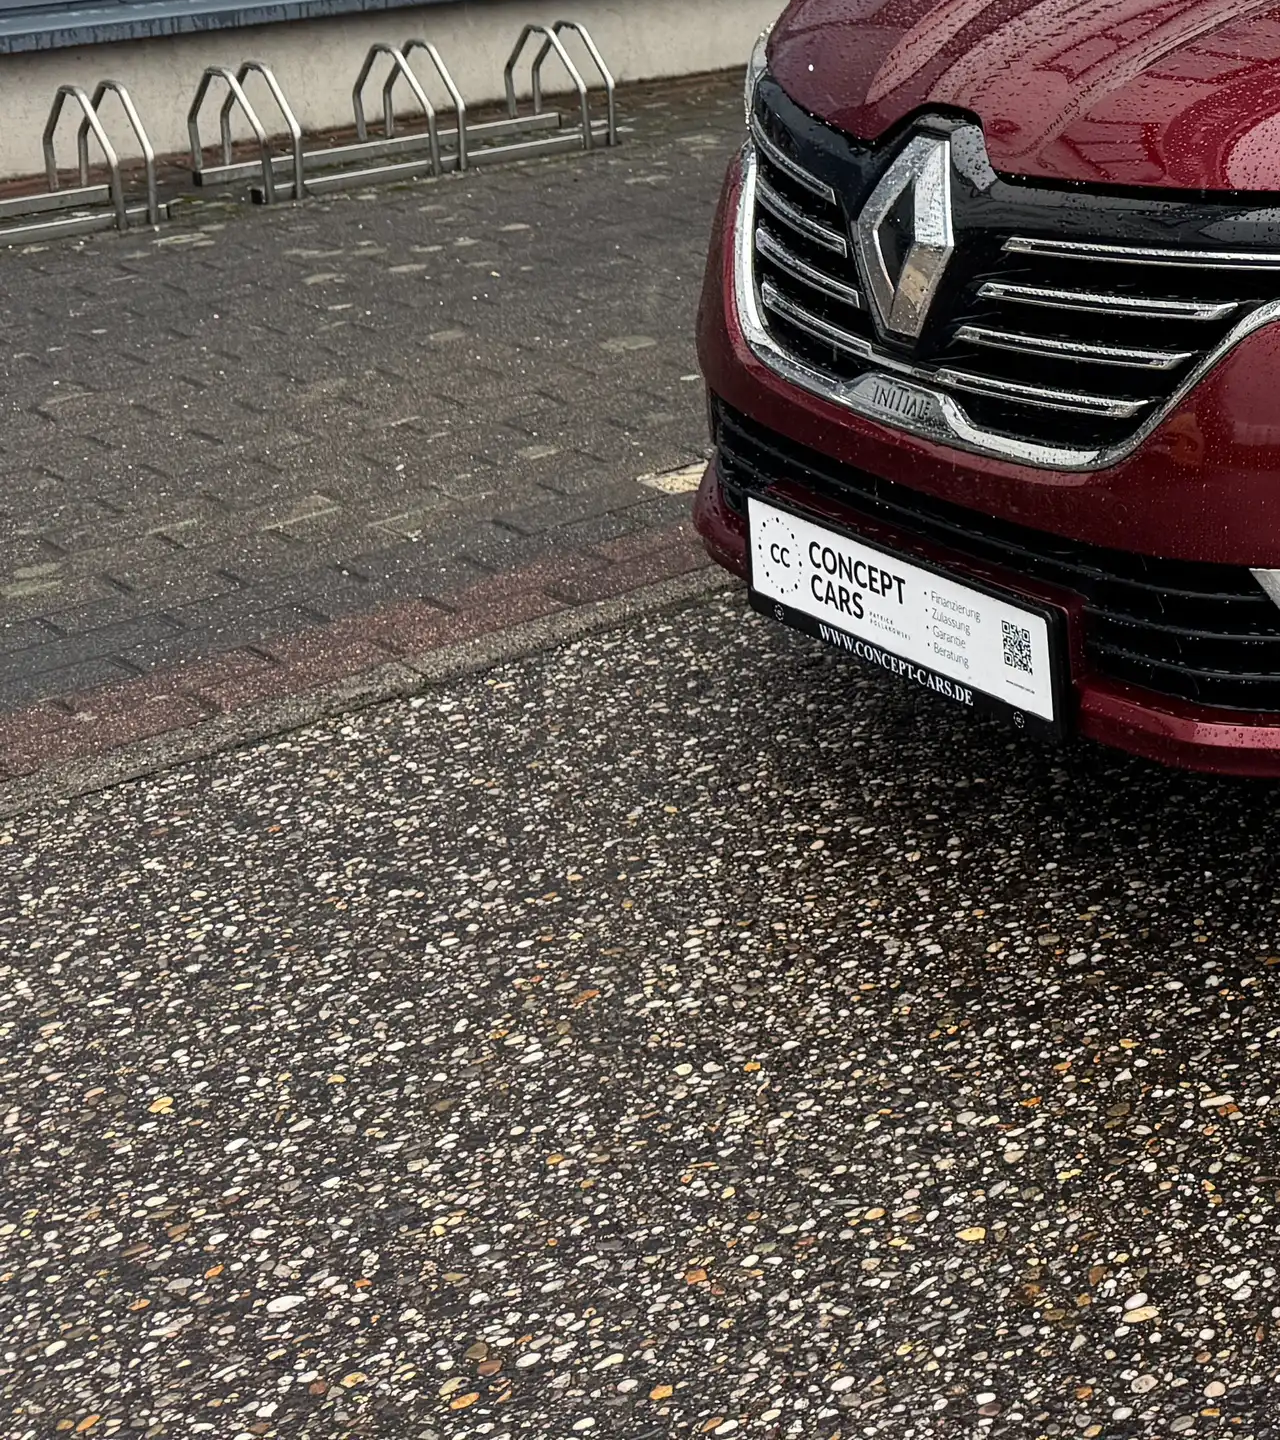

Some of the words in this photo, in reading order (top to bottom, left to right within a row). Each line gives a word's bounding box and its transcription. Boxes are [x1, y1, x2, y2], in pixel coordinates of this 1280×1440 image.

[770, 543, 791, 568] CC
[808, 541, 906, 605] CONCEPT
[811, 574, 864, 620] CARS
[931, 591, 981, 624] Finanzierung
[931, 607, 971, 636] Zulassung
[932, 625, 966, 649] Garantie
[818, 623, 974, 707] WWW.CONCEPT-CARS.DE
[933, 642, 969, 670] Beratung
